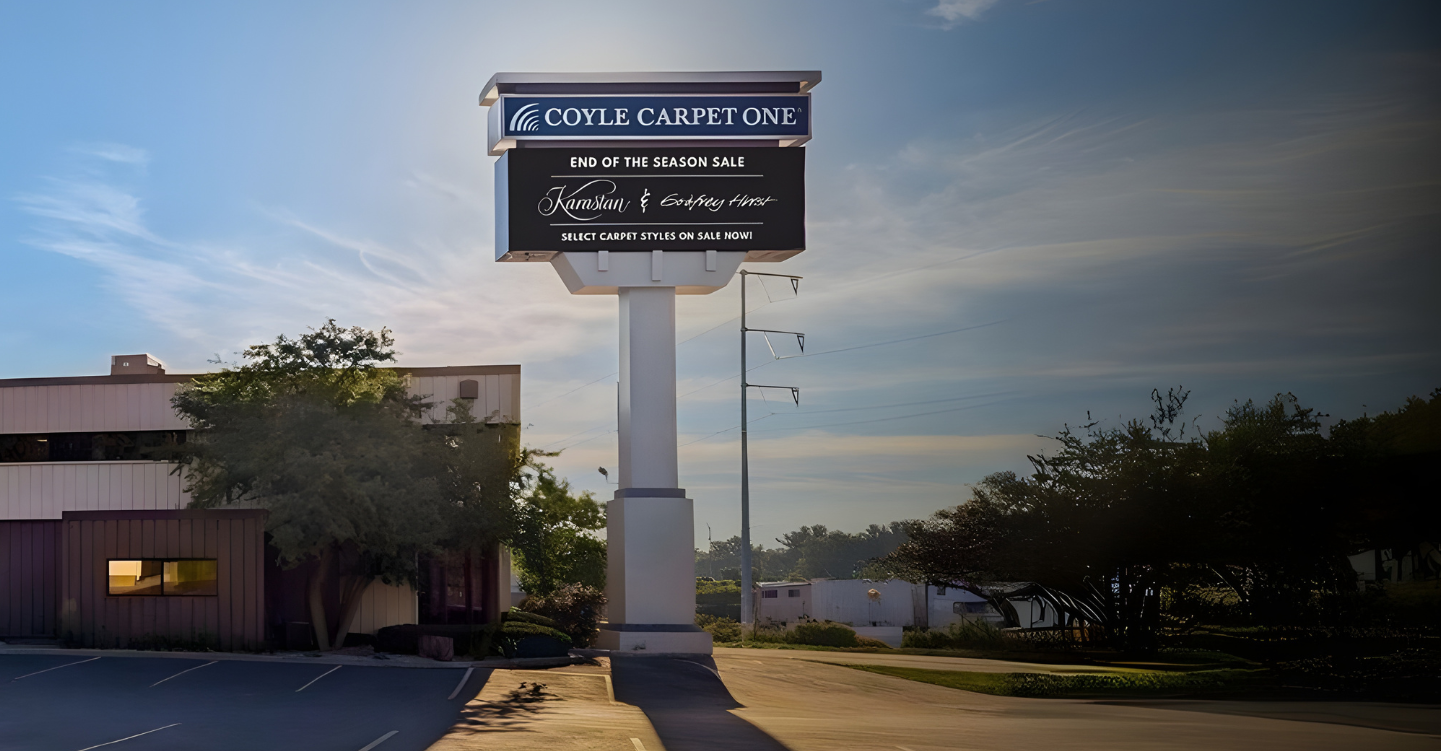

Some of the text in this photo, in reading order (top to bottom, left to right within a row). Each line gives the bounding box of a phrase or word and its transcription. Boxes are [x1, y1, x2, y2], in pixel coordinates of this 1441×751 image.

[544, 107, 797, 126] COYLE CARPET ONE
[570, 156, 745, 168] END OF THE SEASON SALE
[561, 231, 753, 242] SELECT CARPET STYLES ON SALE NOW!
